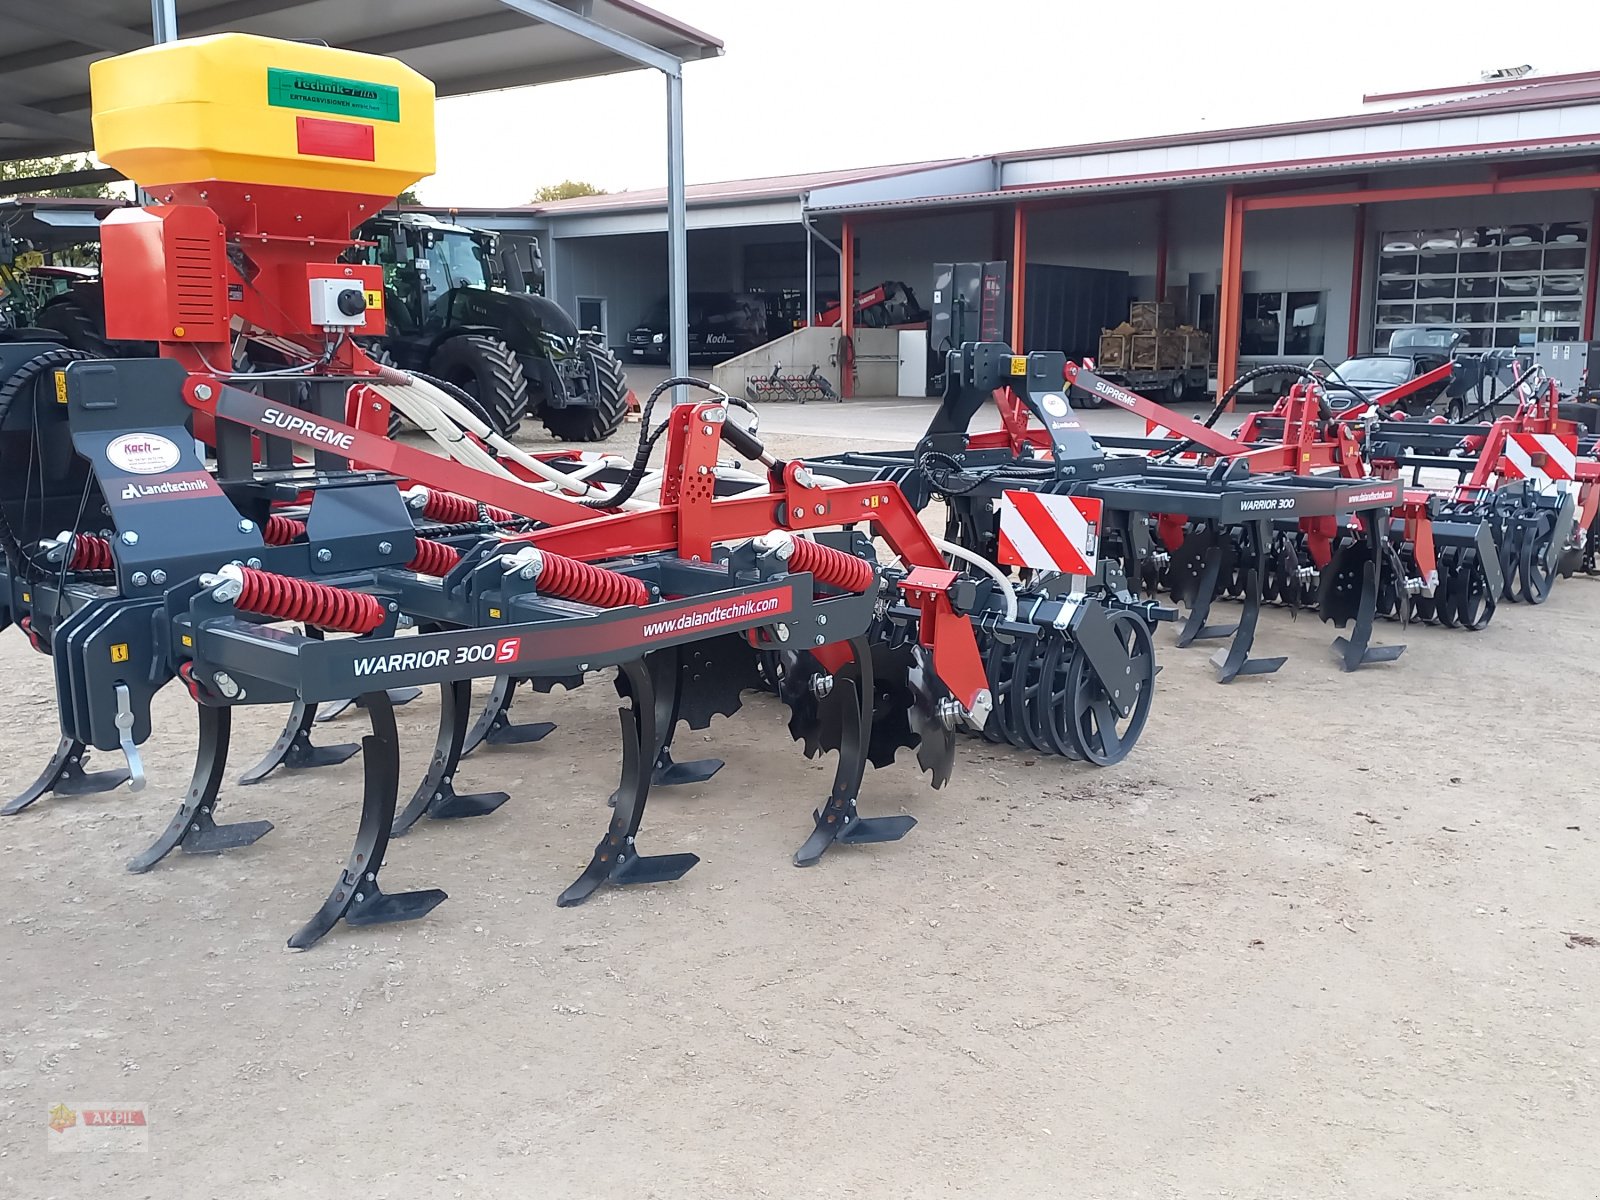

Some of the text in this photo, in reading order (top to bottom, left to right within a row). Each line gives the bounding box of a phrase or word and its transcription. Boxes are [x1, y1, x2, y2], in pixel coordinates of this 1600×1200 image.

[706, 333, 727, 344] Koch
[1095, 381, 1137, 407] SUPREME
[260, 408, 355, 450] SUPREME
[124, 442, 152, 454] Koch
[1240, 498, 1295, 511] WARRIOR 300
[643, 597, 778, 638] www.dalandtechnik.com
[353, 649, 450, 676] WARRIOR
